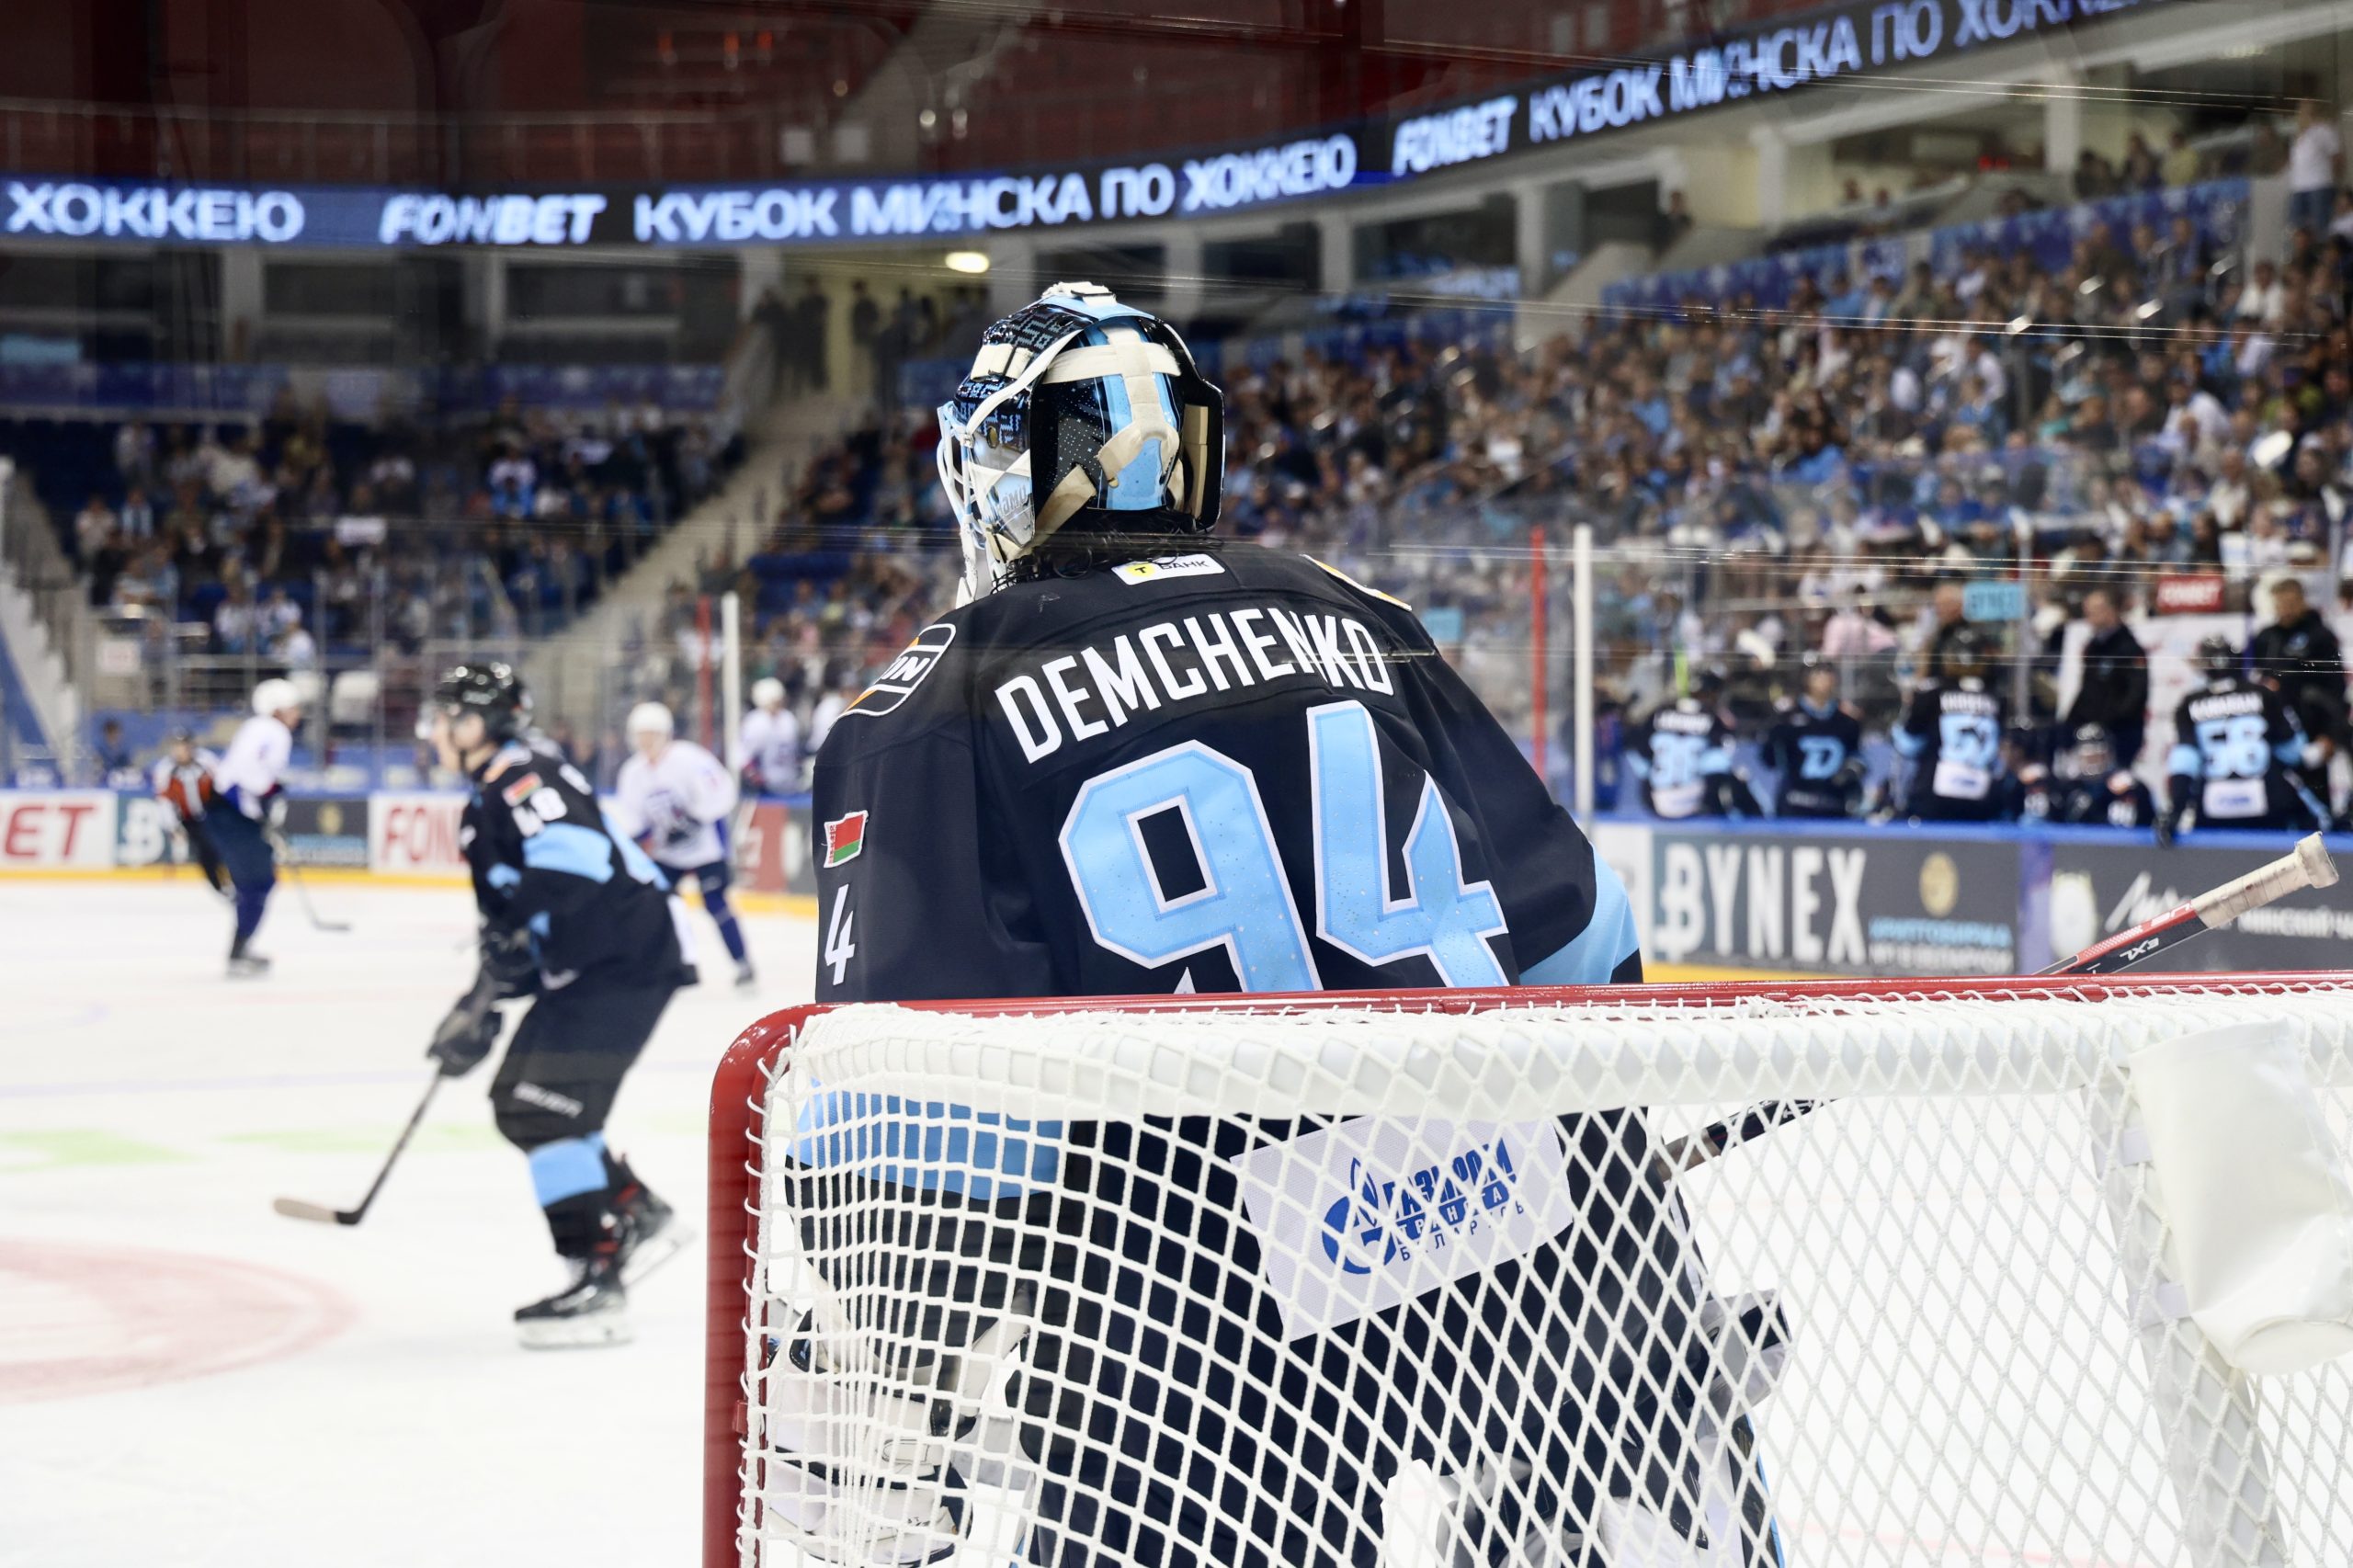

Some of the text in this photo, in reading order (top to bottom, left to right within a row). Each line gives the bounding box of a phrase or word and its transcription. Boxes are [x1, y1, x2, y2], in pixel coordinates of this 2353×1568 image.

[1392, 95, 1518, 177] FONBET
[1527, 68, 1665, 143] КУБОК
[1871, 0, 1944, 66] ПО
[4, 181, 306, 243] ХОККЕЮ
[379, 133, 1358, 245] FONBET КУБОК МИНСКА ПО ХОККЕЮ
[995, 608, 1394, 765] DEMCHENKO
[1058, 699, 1508, 994] 94
[1654, 841, 1867, 965] BYNEX
